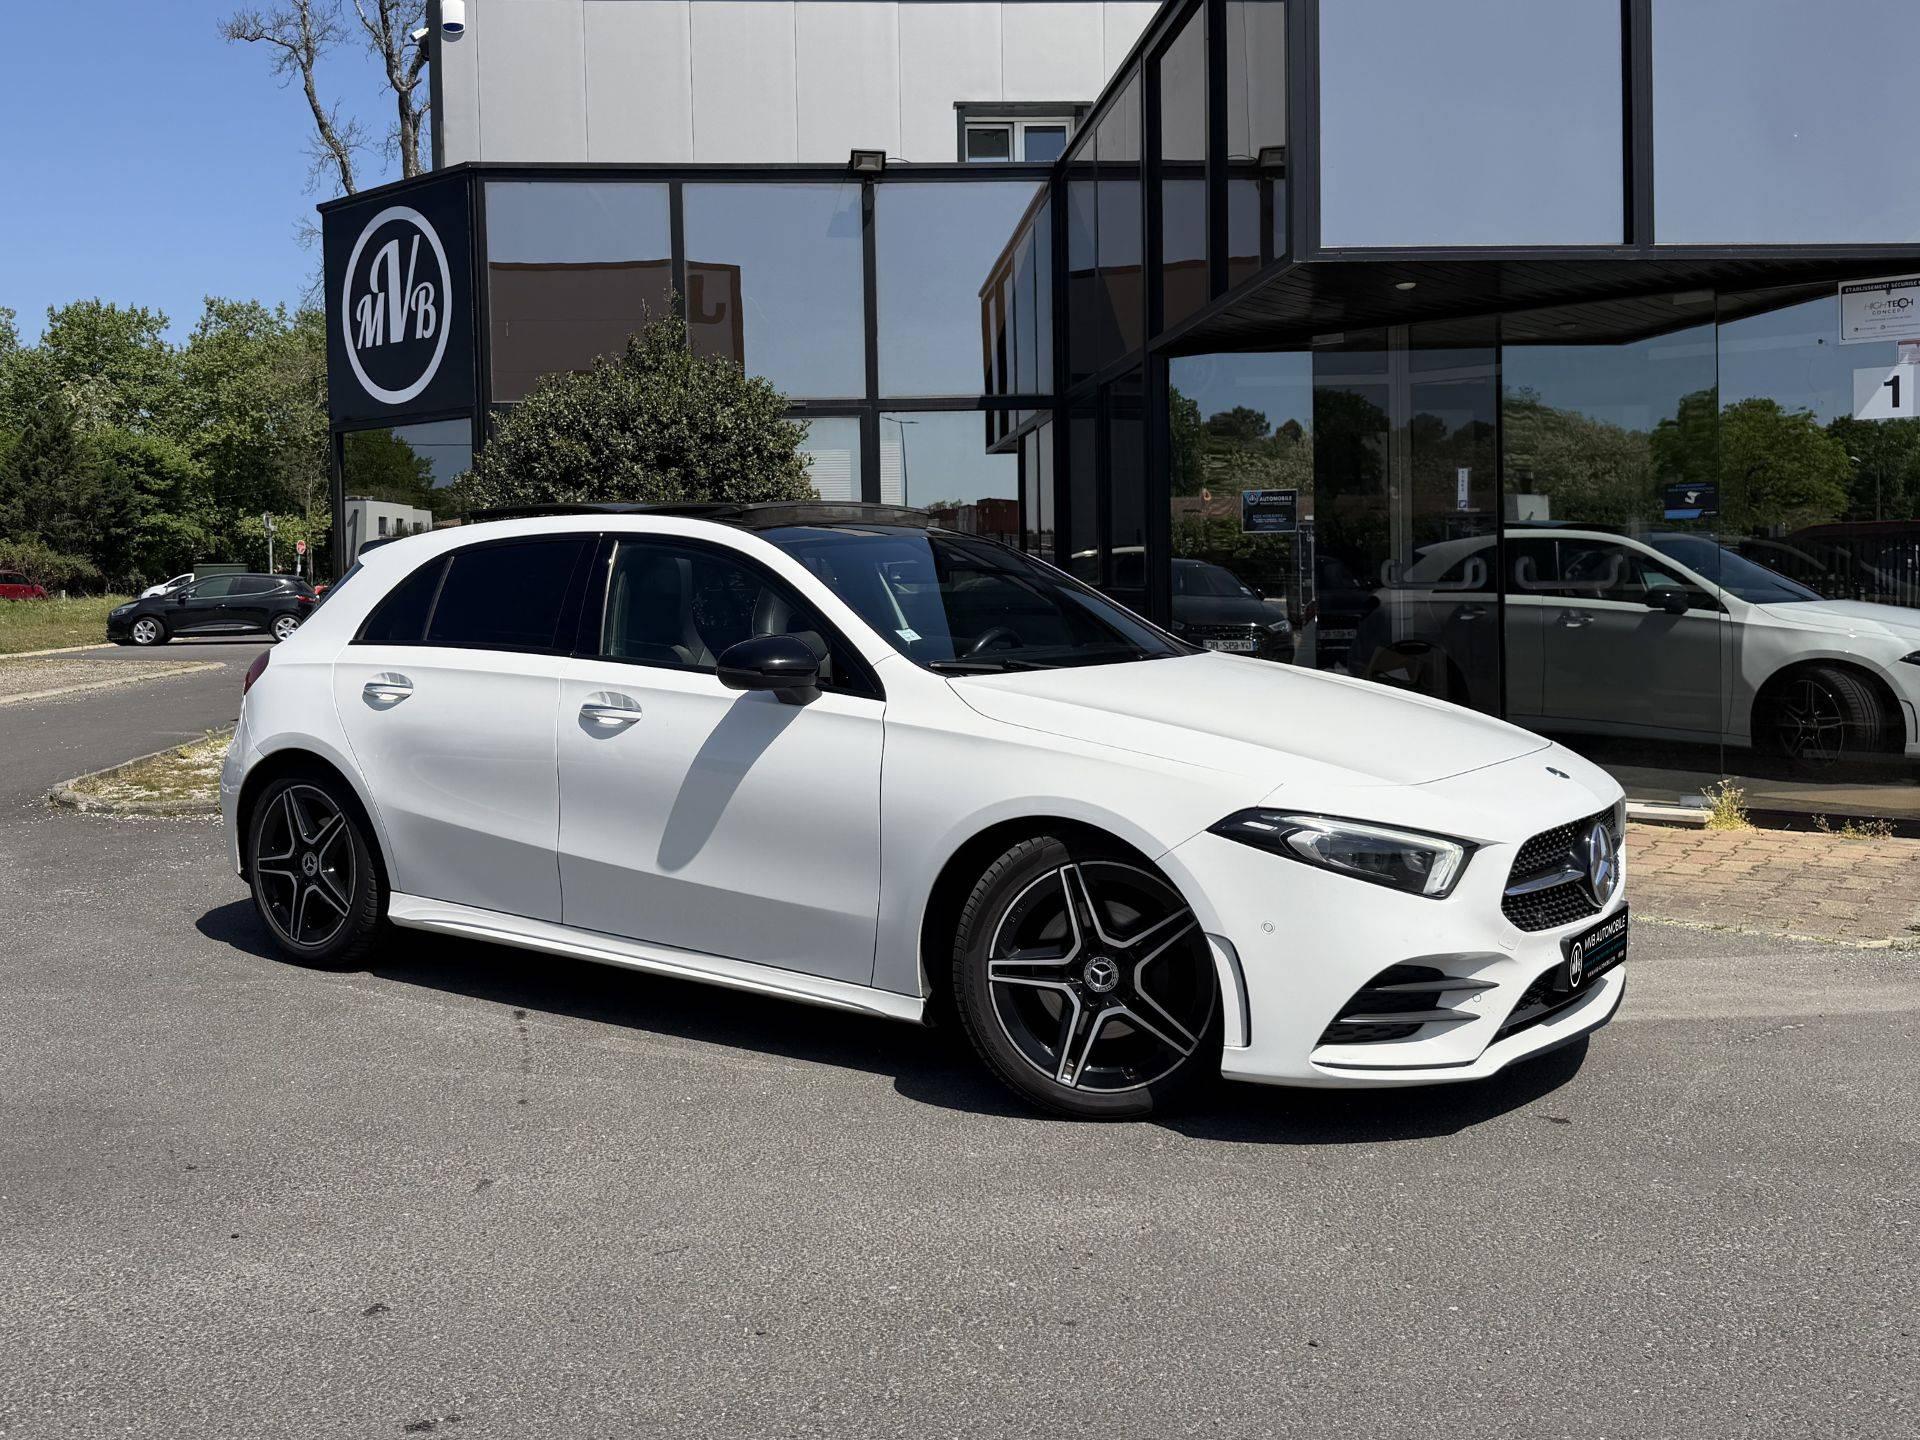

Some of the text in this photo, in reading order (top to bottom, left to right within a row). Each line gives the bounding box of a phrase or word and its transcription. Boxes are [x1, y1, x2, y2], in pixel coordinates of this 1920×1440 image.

[356, 235, 437, 349] MVB
[1884, 375, 1900, 408] 1
[1595, 914, 1626, 944] AUTOMOBILE
